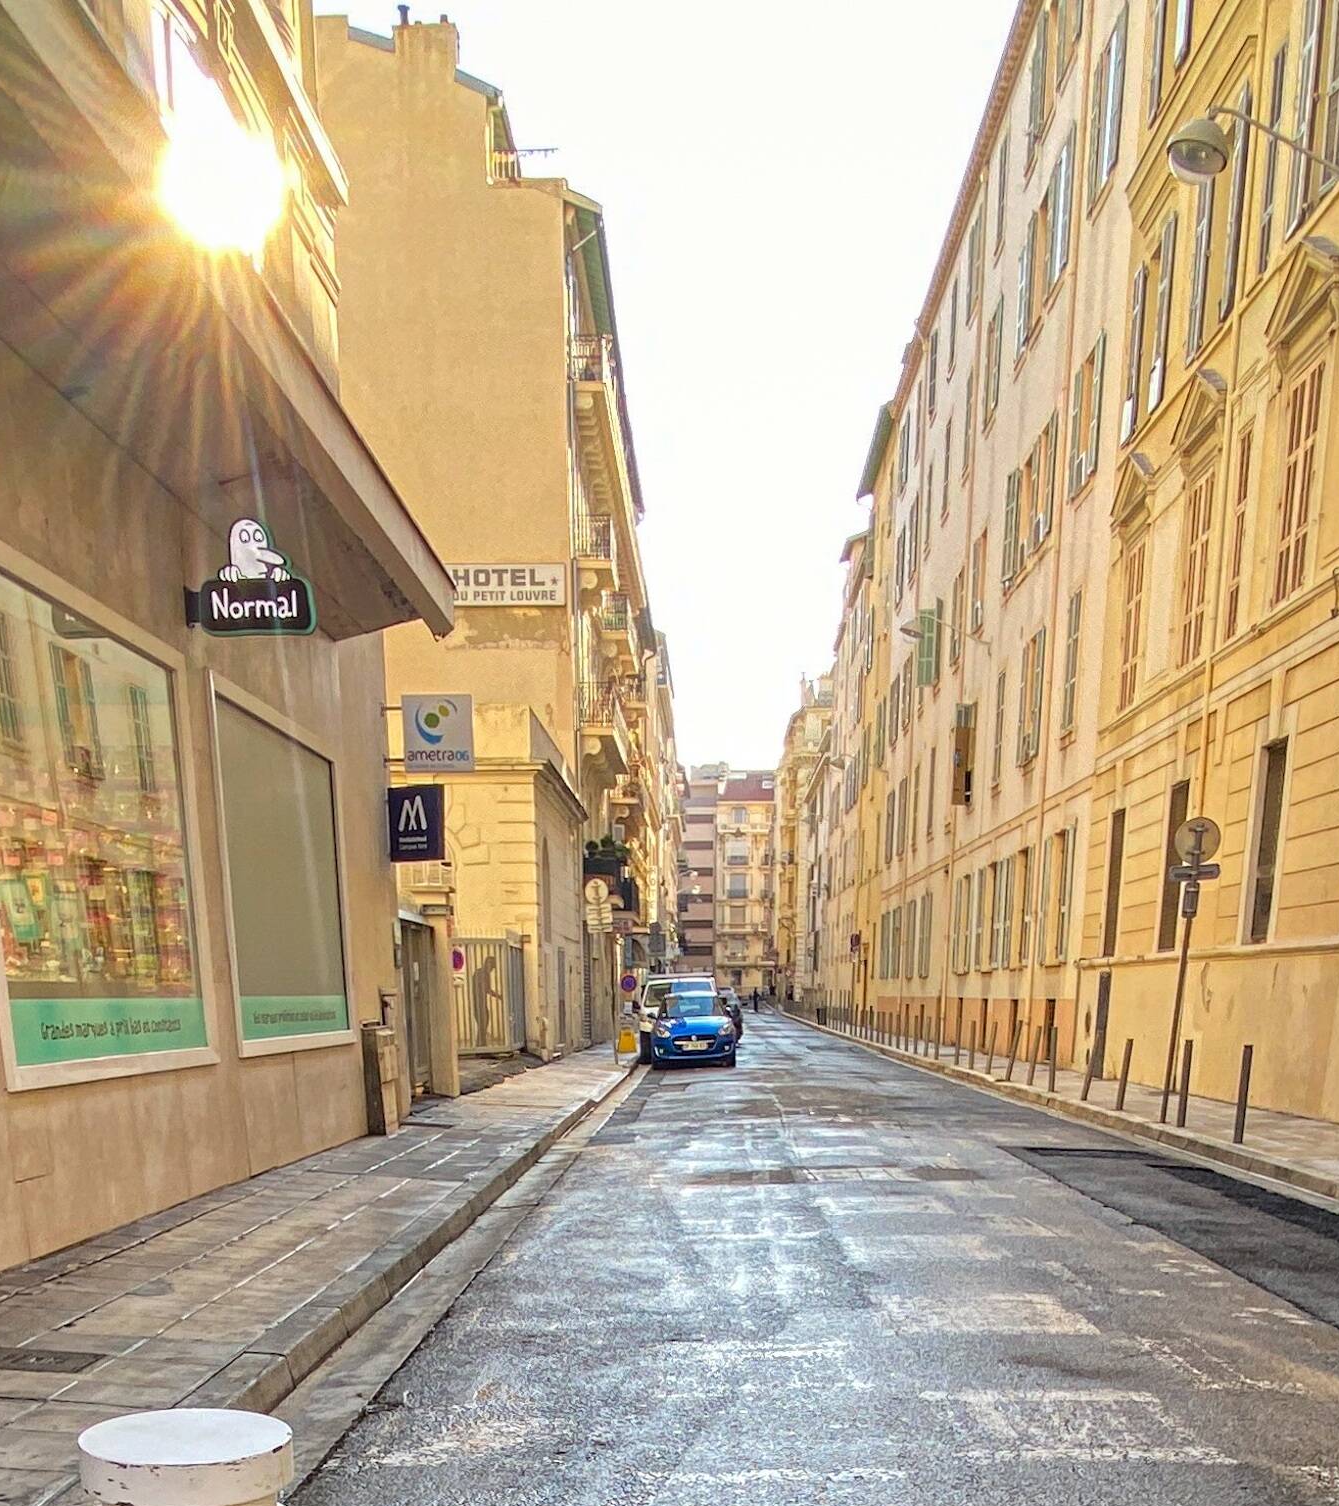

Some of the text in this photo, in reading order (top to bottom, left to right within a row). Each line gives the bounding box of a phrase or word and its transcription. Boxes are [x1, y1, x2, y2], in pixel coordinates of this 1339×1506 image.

[452, 568, 545, 586] HOTEL
[210, 587, 298, 620] Normal
[473, 590, 506, 601] PETIT
[510, 590, 556, 601] LOUVRE
